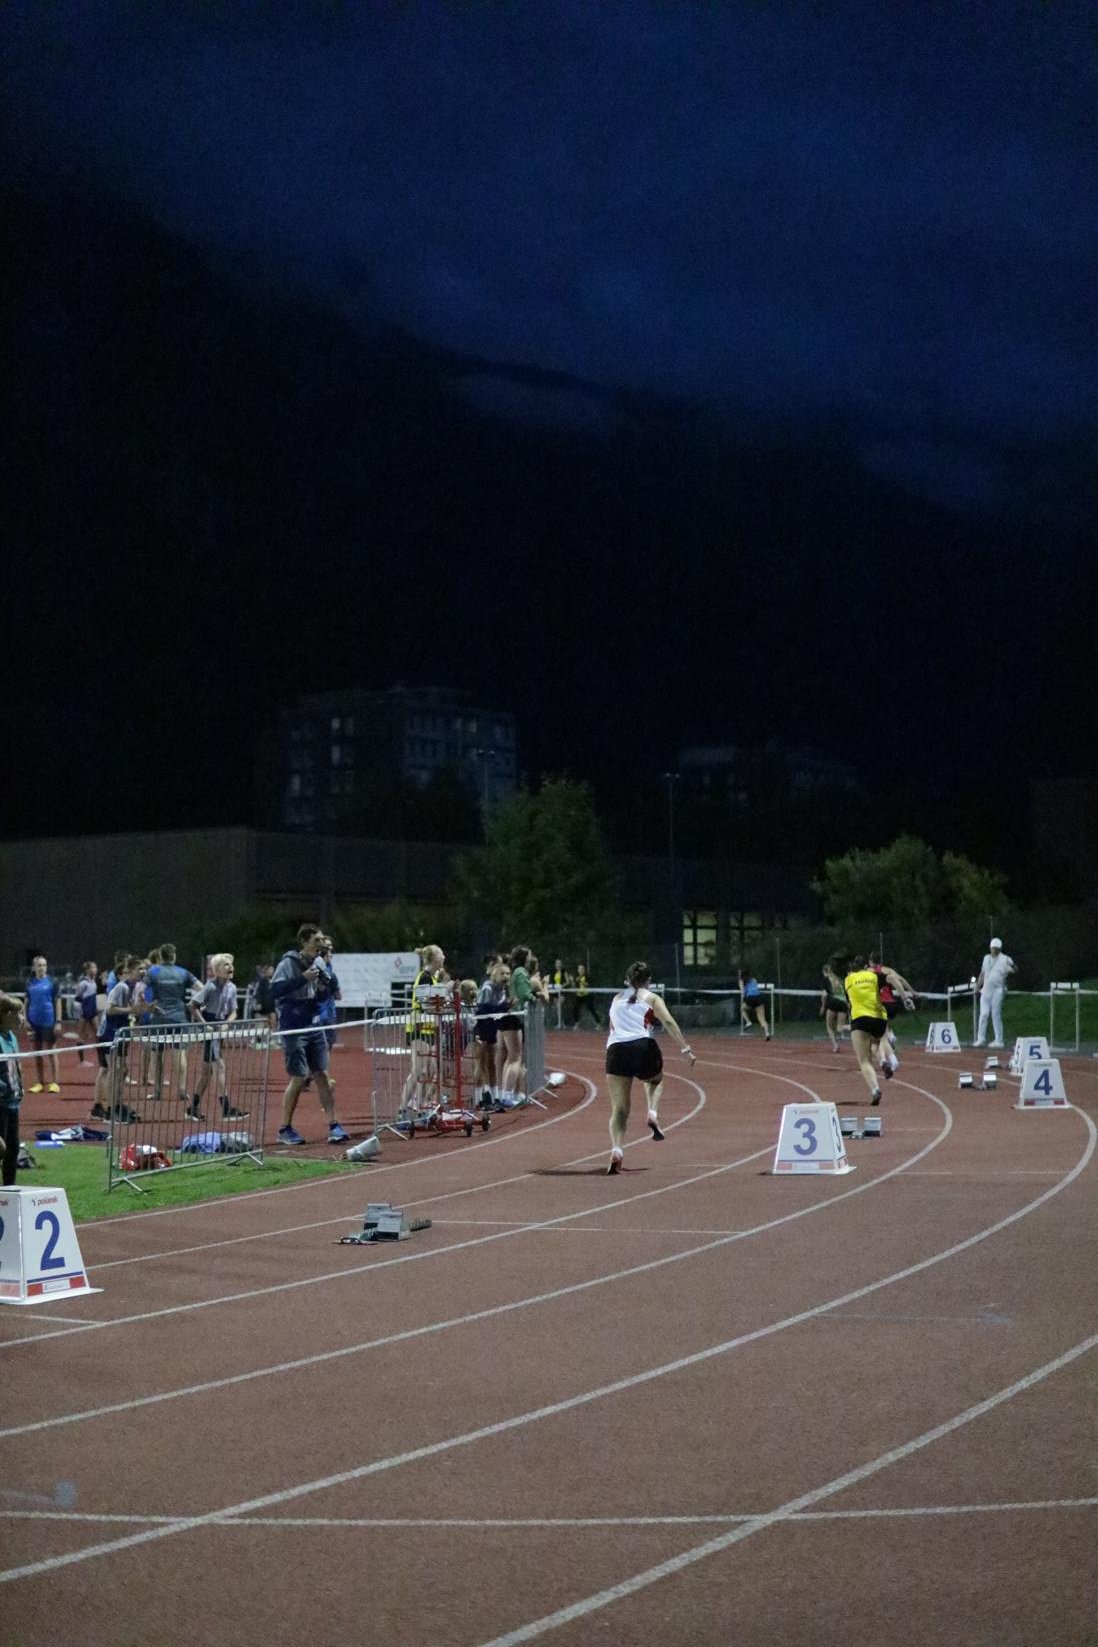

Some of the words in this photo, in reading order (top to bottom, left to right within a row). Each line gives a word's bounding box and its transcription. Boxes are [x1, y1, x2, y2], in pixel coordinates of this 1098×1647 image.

[941, 1029, 952, 1044] 6
[1029, 1045, 1042, 1059] 5
[1034, 1069, 1053, 1096] 4
[793, 1118, 817, 1155] 3
[35, 1210, 65, 1271] 2
